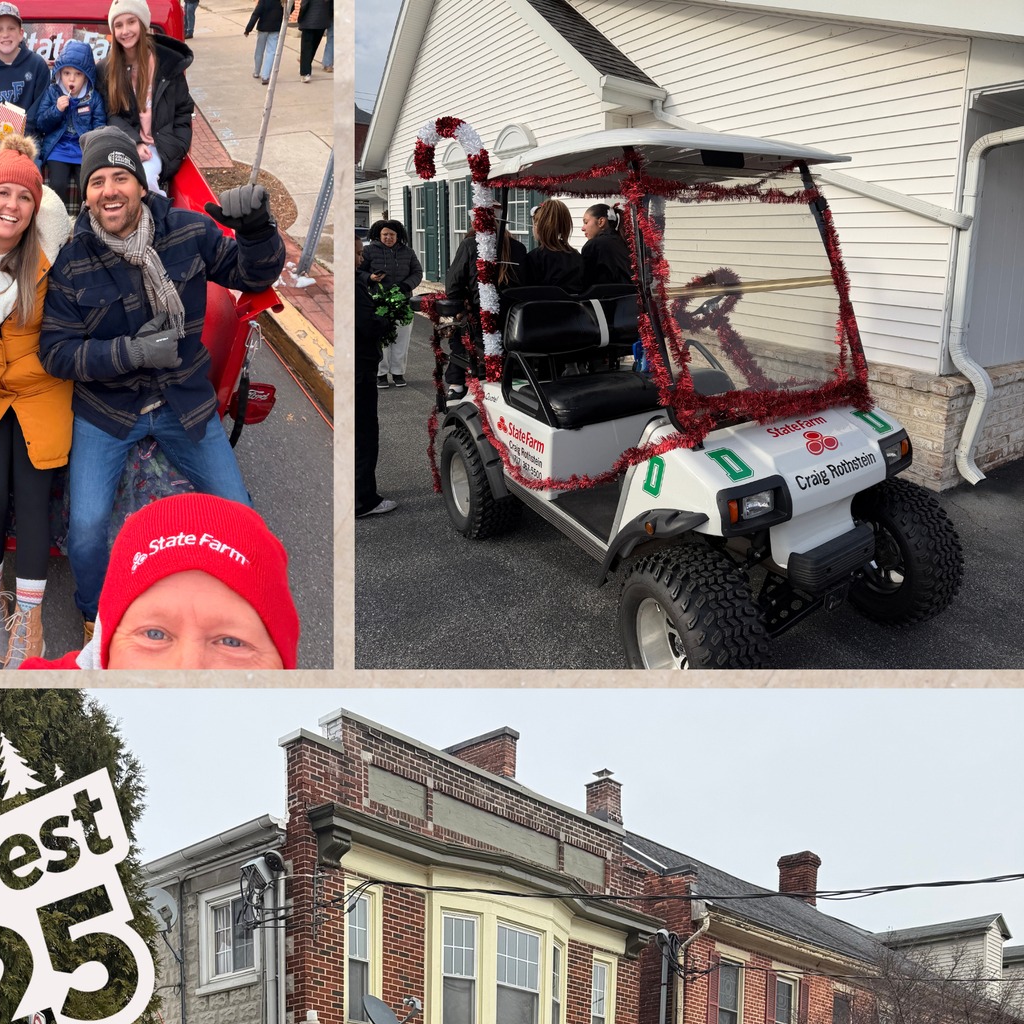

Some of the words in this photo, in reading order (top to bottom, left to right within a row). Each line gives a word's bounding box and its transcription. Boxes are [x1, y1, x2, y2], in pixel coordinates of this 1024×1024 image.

[795, 467, 829, 491] Craig
[827, 452, 877, 480] Rothstein
[149, 531, 197, 556] State
[198, 532, 246, 566] Farm
